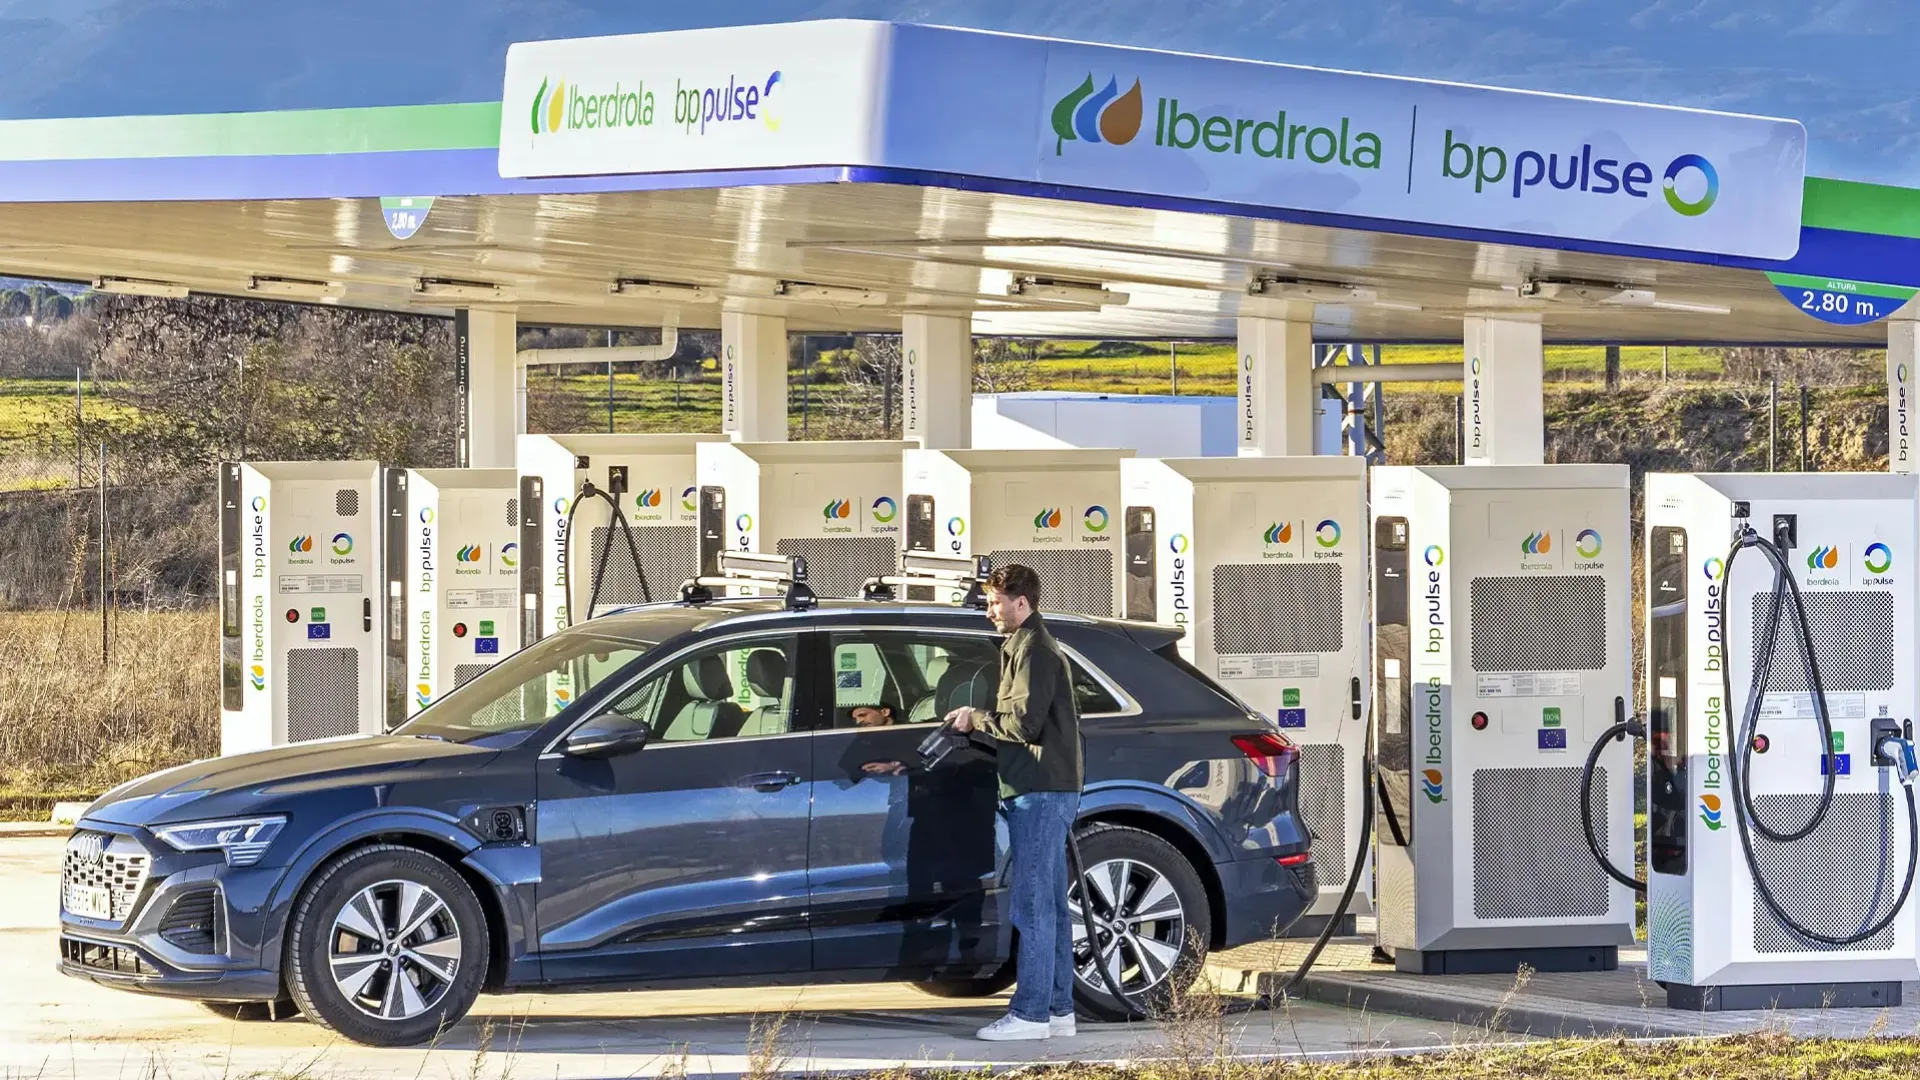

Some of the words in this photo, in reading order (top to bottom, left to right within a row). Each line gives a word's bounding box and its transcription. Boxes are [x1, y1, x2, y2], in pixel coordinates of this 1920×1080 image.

[567, 80, 654, 131] Iberdrola
[1155, 97, 1382, 169] Iberdrola
[1801, 290, 1849, 313] 2,80
[1856, 300, 1880, 317] m.
[1827, 281, 1857, 291] ALTURA
[253, 595, 264, 661] Iberdrola
[419, 610, 430, 680] Iberdrola
[738, 648, 751, 703] Iberdro
[1425, 676, 1441, 765] Iberdrola
[1704, 697, 1720, 789] Iberdrola
